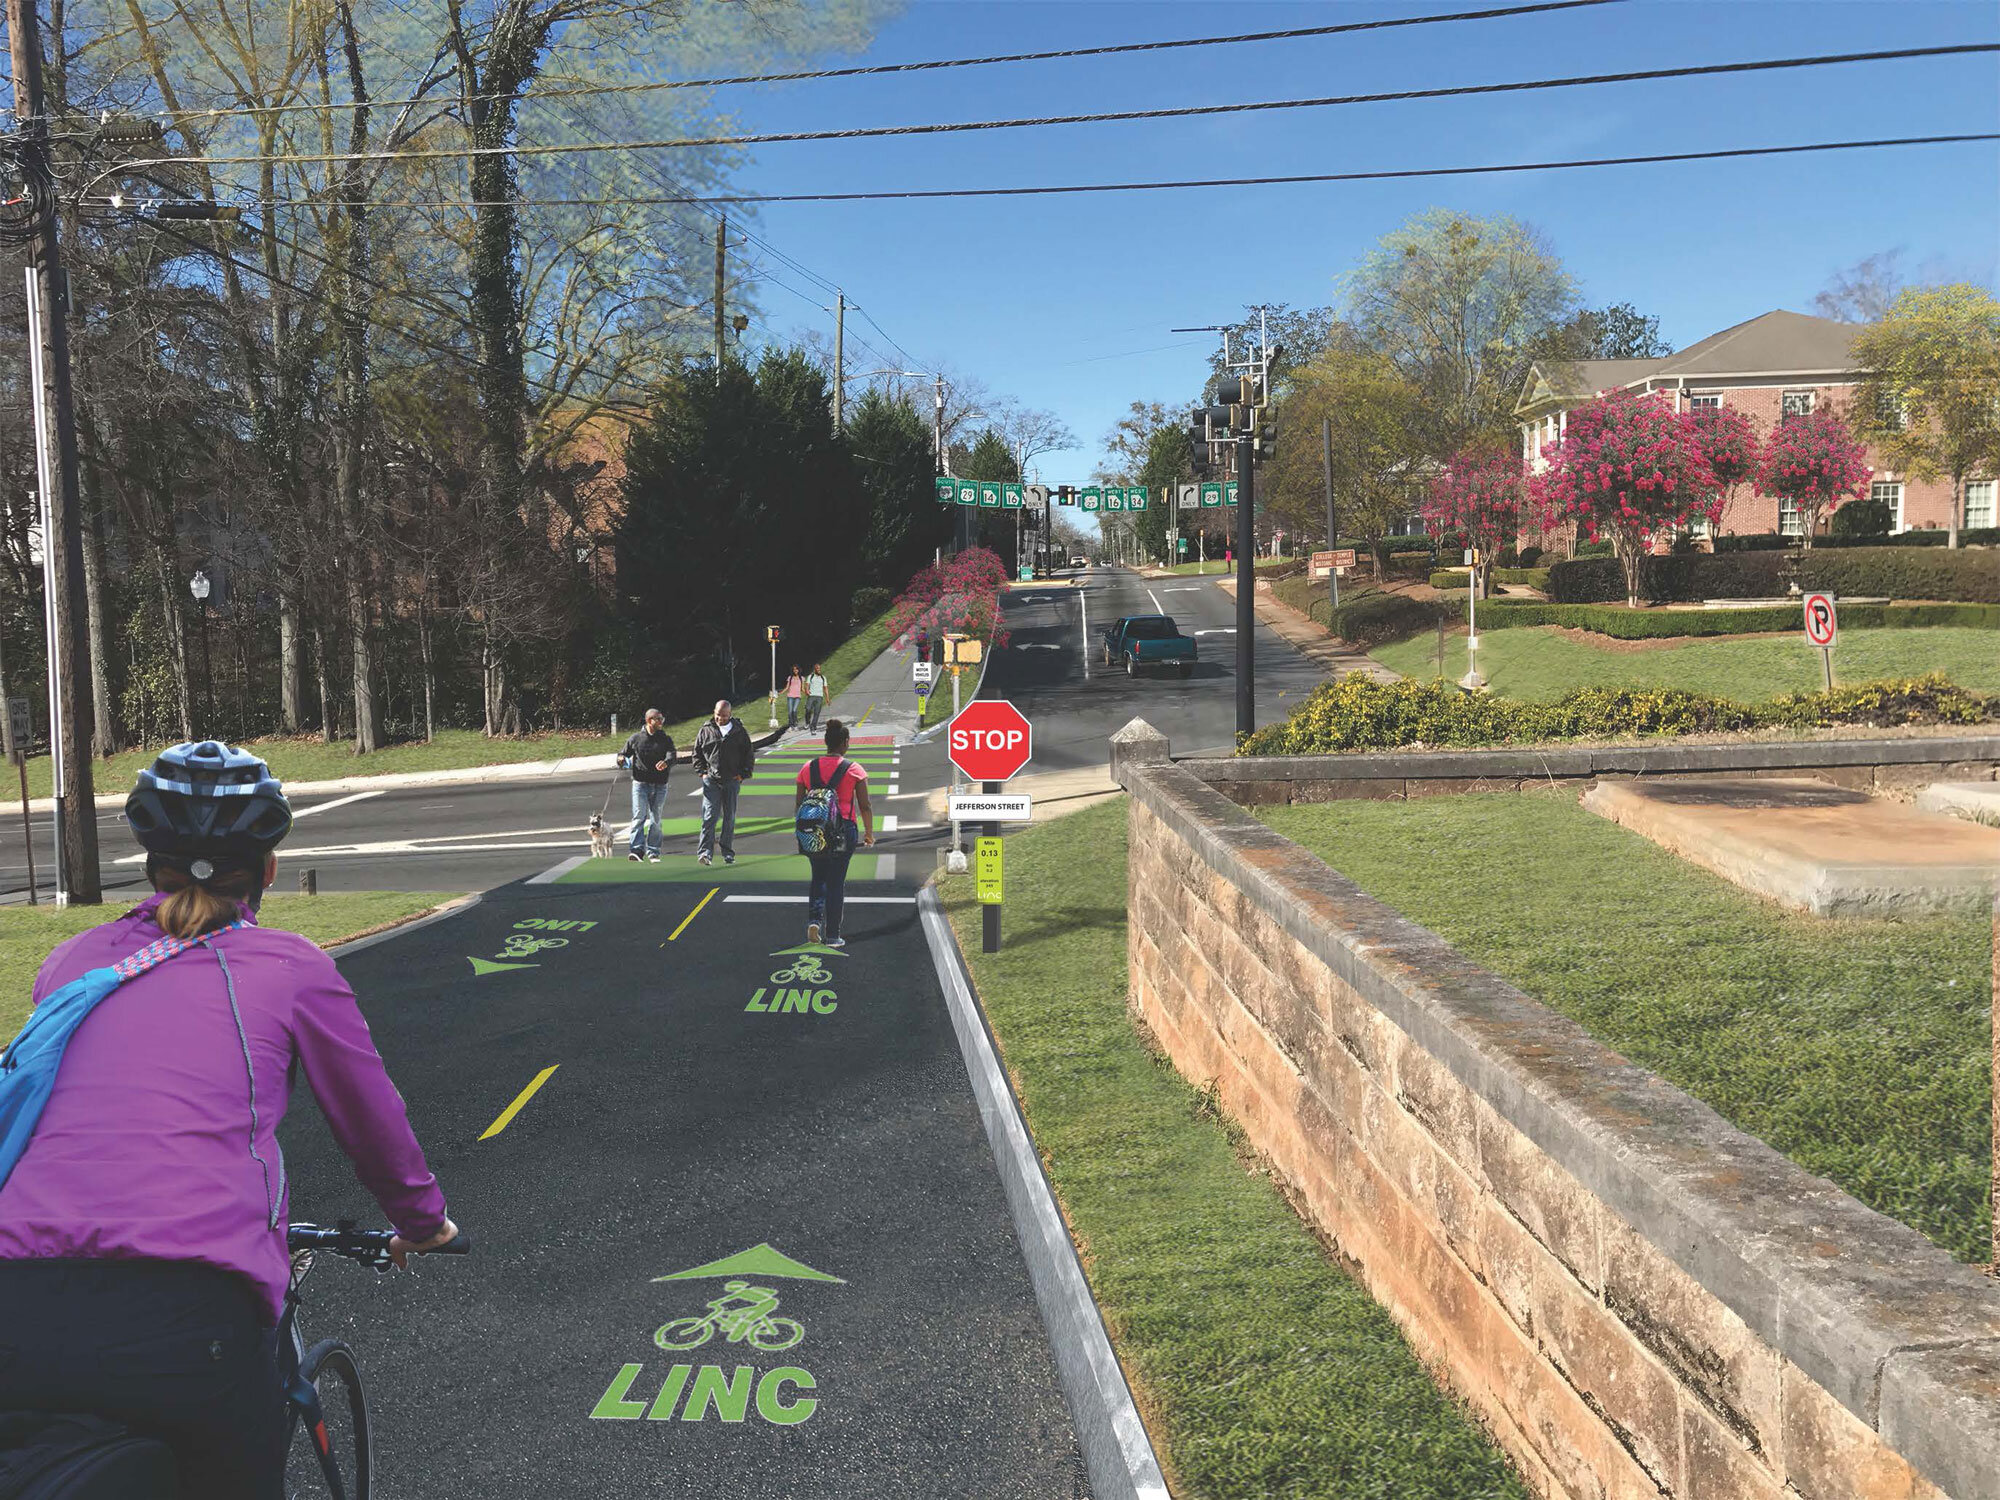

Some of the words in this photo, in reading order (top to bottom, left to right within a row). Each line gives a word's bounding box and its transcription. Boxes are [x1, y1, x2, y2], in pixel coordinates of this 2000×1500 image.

[963, 490, 972, 500] 29
[985, 493, 994, 502] 14
[1008, 494, 1018, 503] 16
[1207, 494, 1217, 502] 29
[1109, 498, 1119, 507] 16
[1132, 497, 1142, 506] 34
[11, 701, 28, 716] ONE
[952, 730, 1023, 751] STOP
[513, 918, 598, 932] LINC
[744, 988, 838, 1014] LINC
[589, 1363, 818, 1426] LINC
